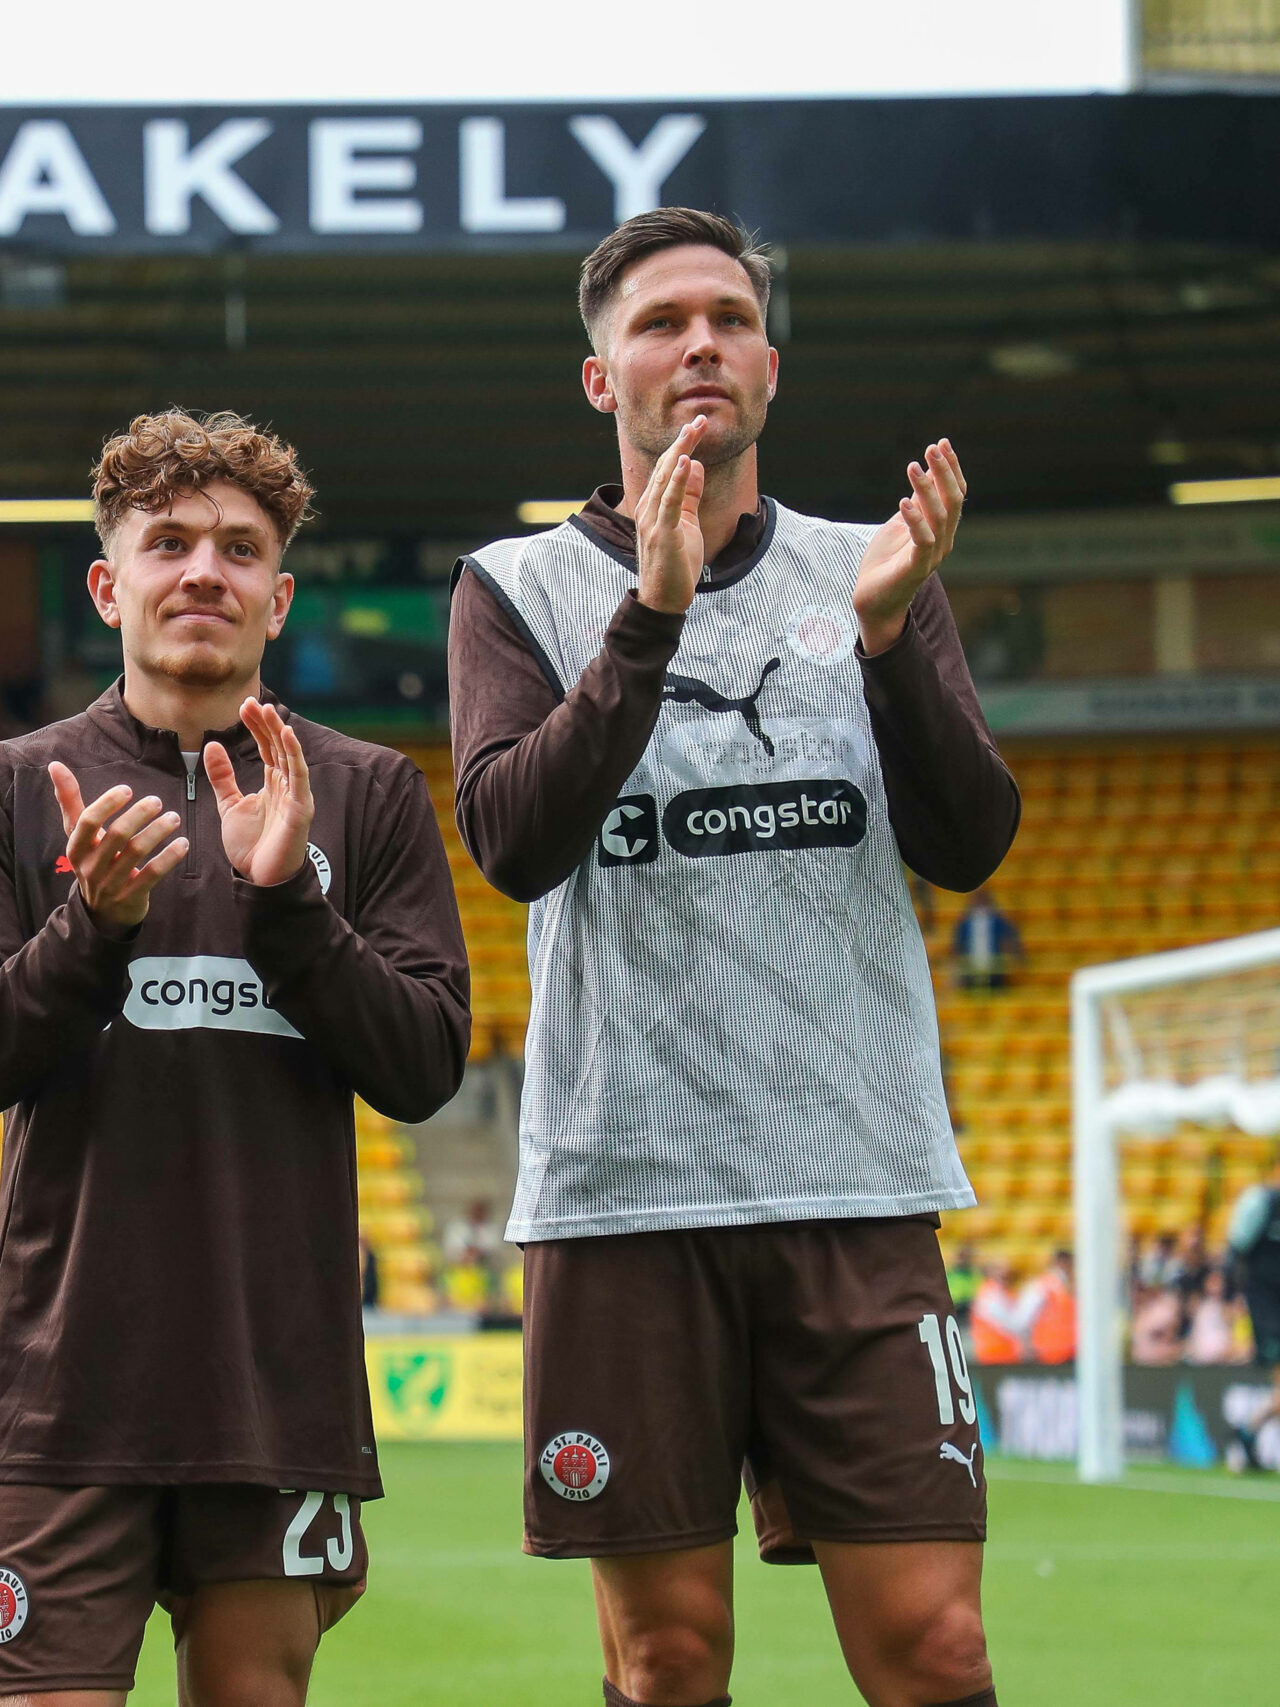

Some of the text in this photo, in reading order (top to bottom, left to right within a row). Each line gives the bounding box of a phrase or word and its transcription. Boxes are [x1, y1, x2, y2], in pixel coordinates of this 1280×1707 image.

[687, 794, 851, 838] congstar
[918, 1313, 976, 1425] 19
[543, 1434, 607, 1466] FC ST. PAULI
[563, 1488, 590, 1499] 1910
[0, 1571, 25, 1601] PAULI
